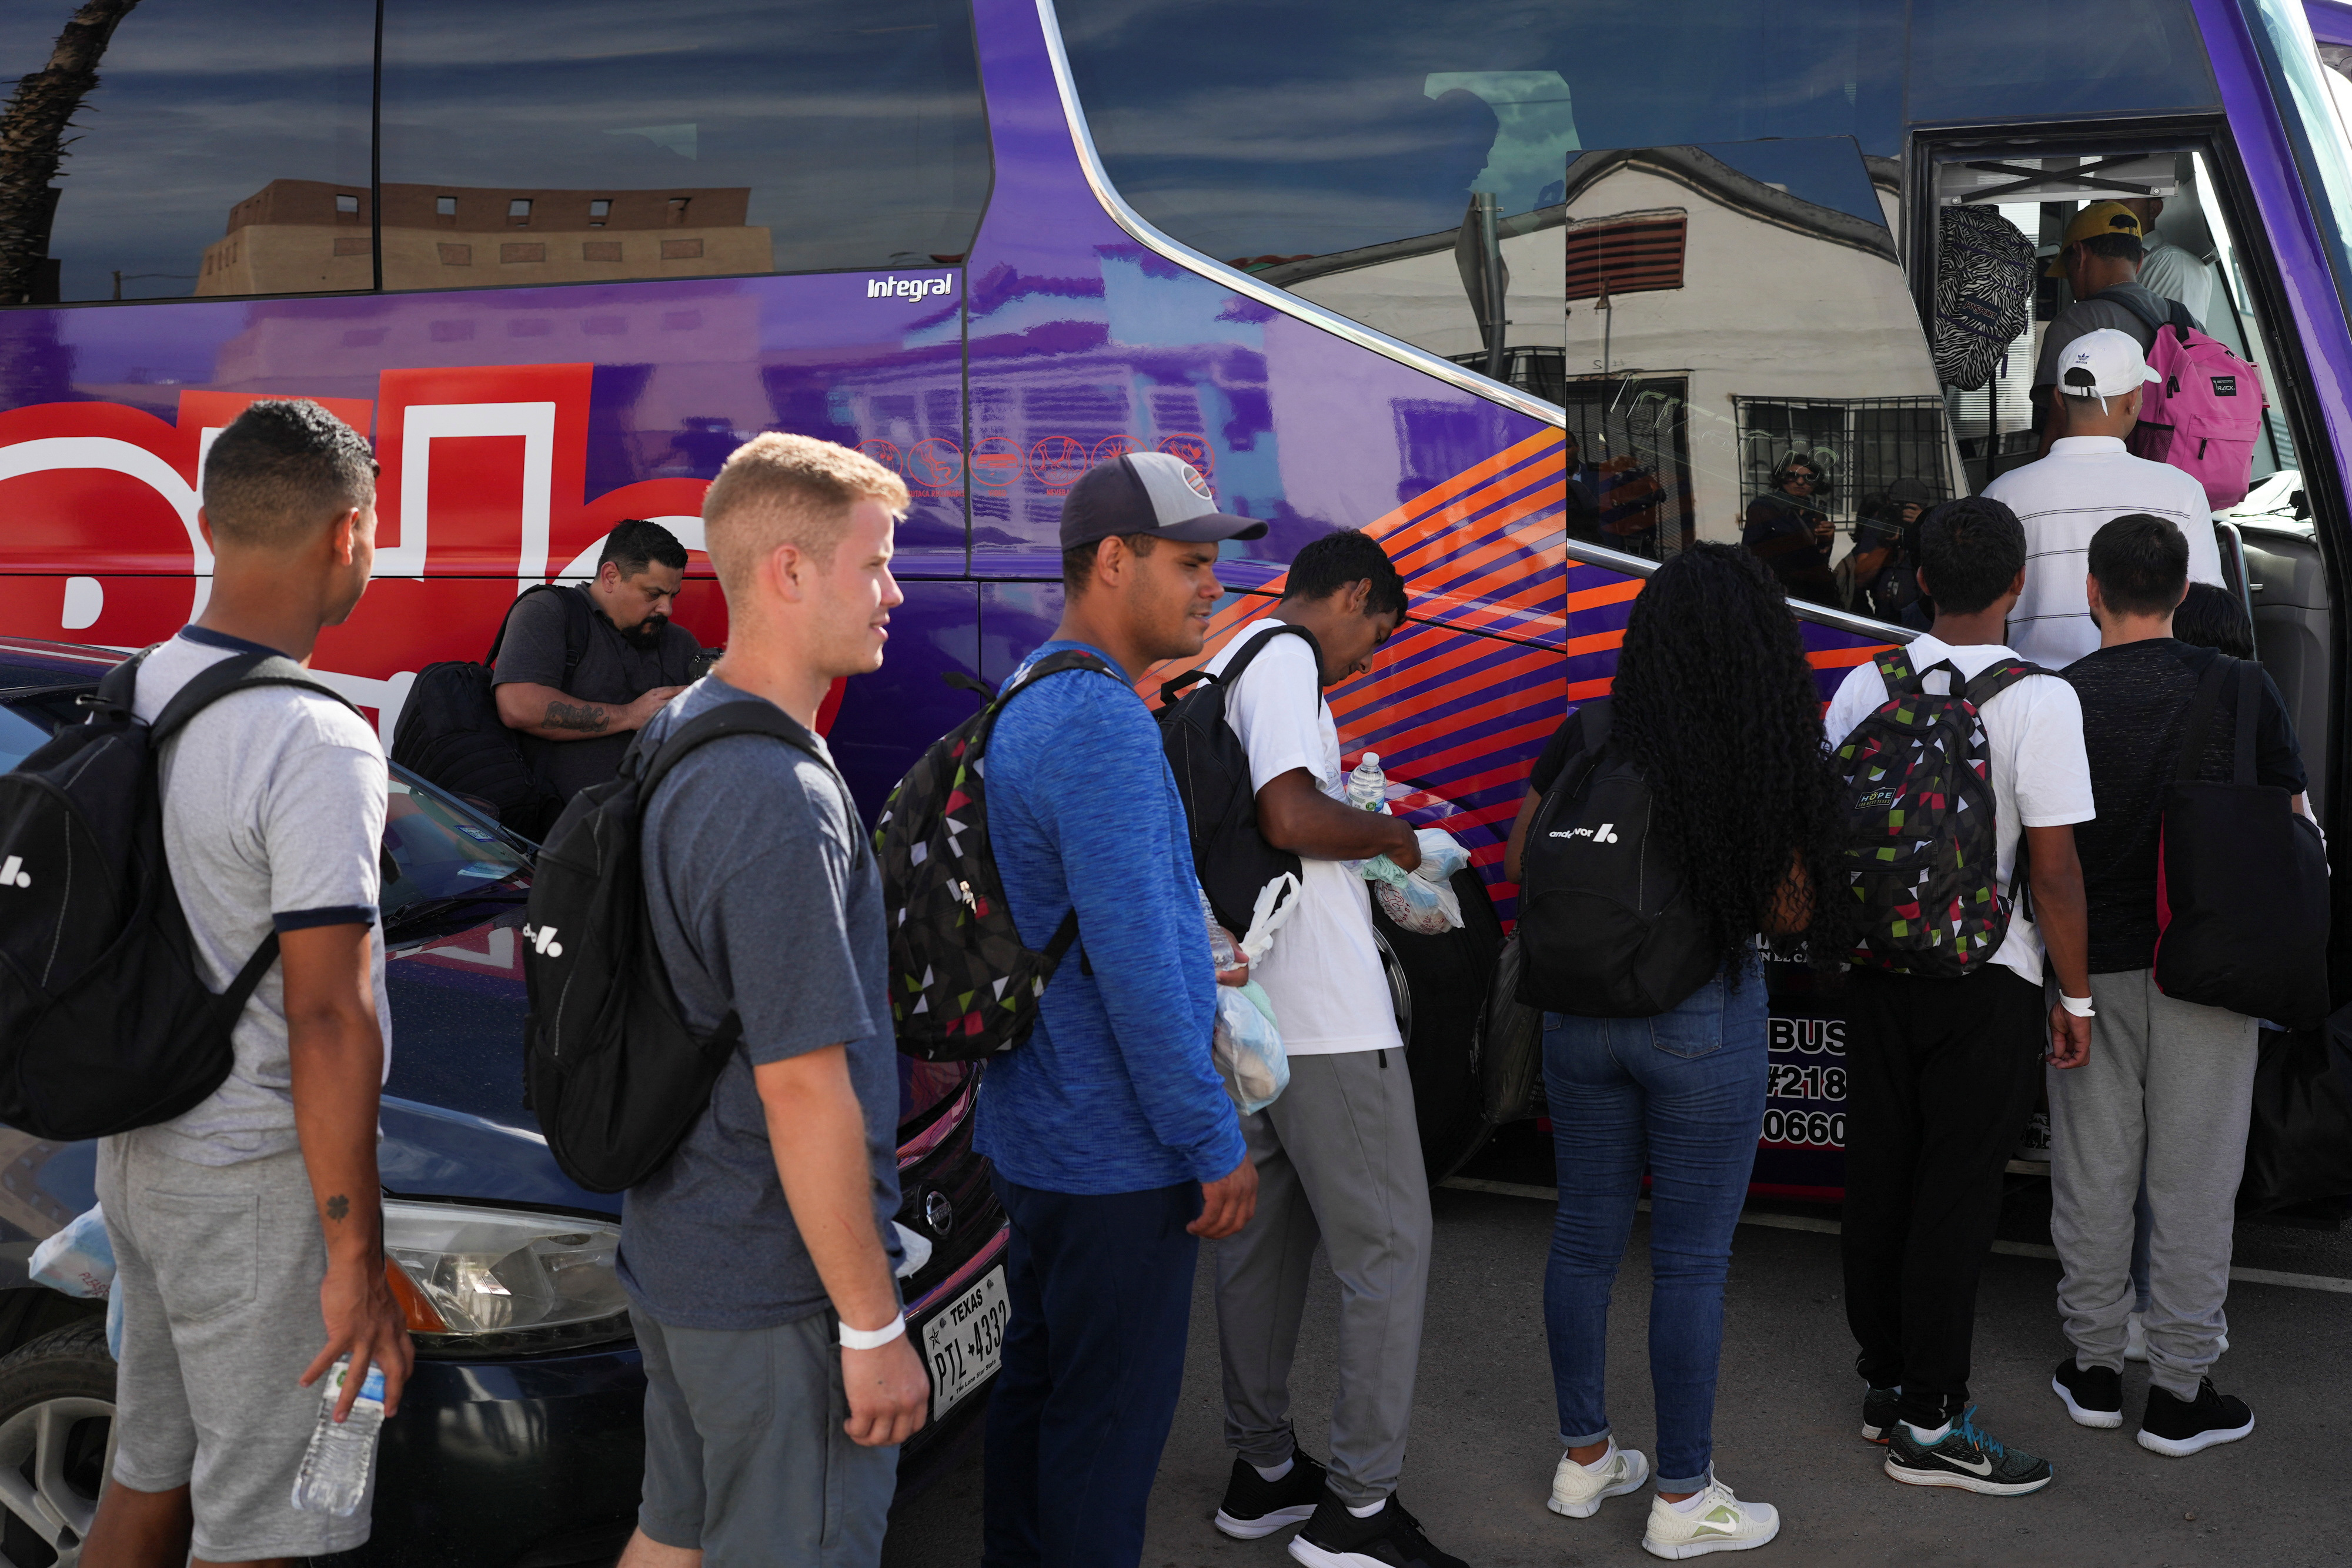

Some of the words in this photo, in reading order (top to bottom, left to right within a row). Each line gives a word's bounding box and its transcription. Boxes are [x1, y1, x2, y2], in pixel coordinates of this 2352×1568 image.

[867, 273, 952, 302] Integral
[1963, 300, 1997, 319] JANSPORT
[1861, 792, 1893, 802] HOPE
[1768, 1018, 1846, 1056] BUS
[1758, 1108, 1846, 1147] 0660
[950, 1288, 983, 1326] TEXAS
[934, 1338, 967, 1397] PTL
[956, 1385, 964, 1394] The
[965, 1376, 975, 1387] Lone
[976, 1369, 985, 1379] Star
[985, 1359, 996, 1370] State
